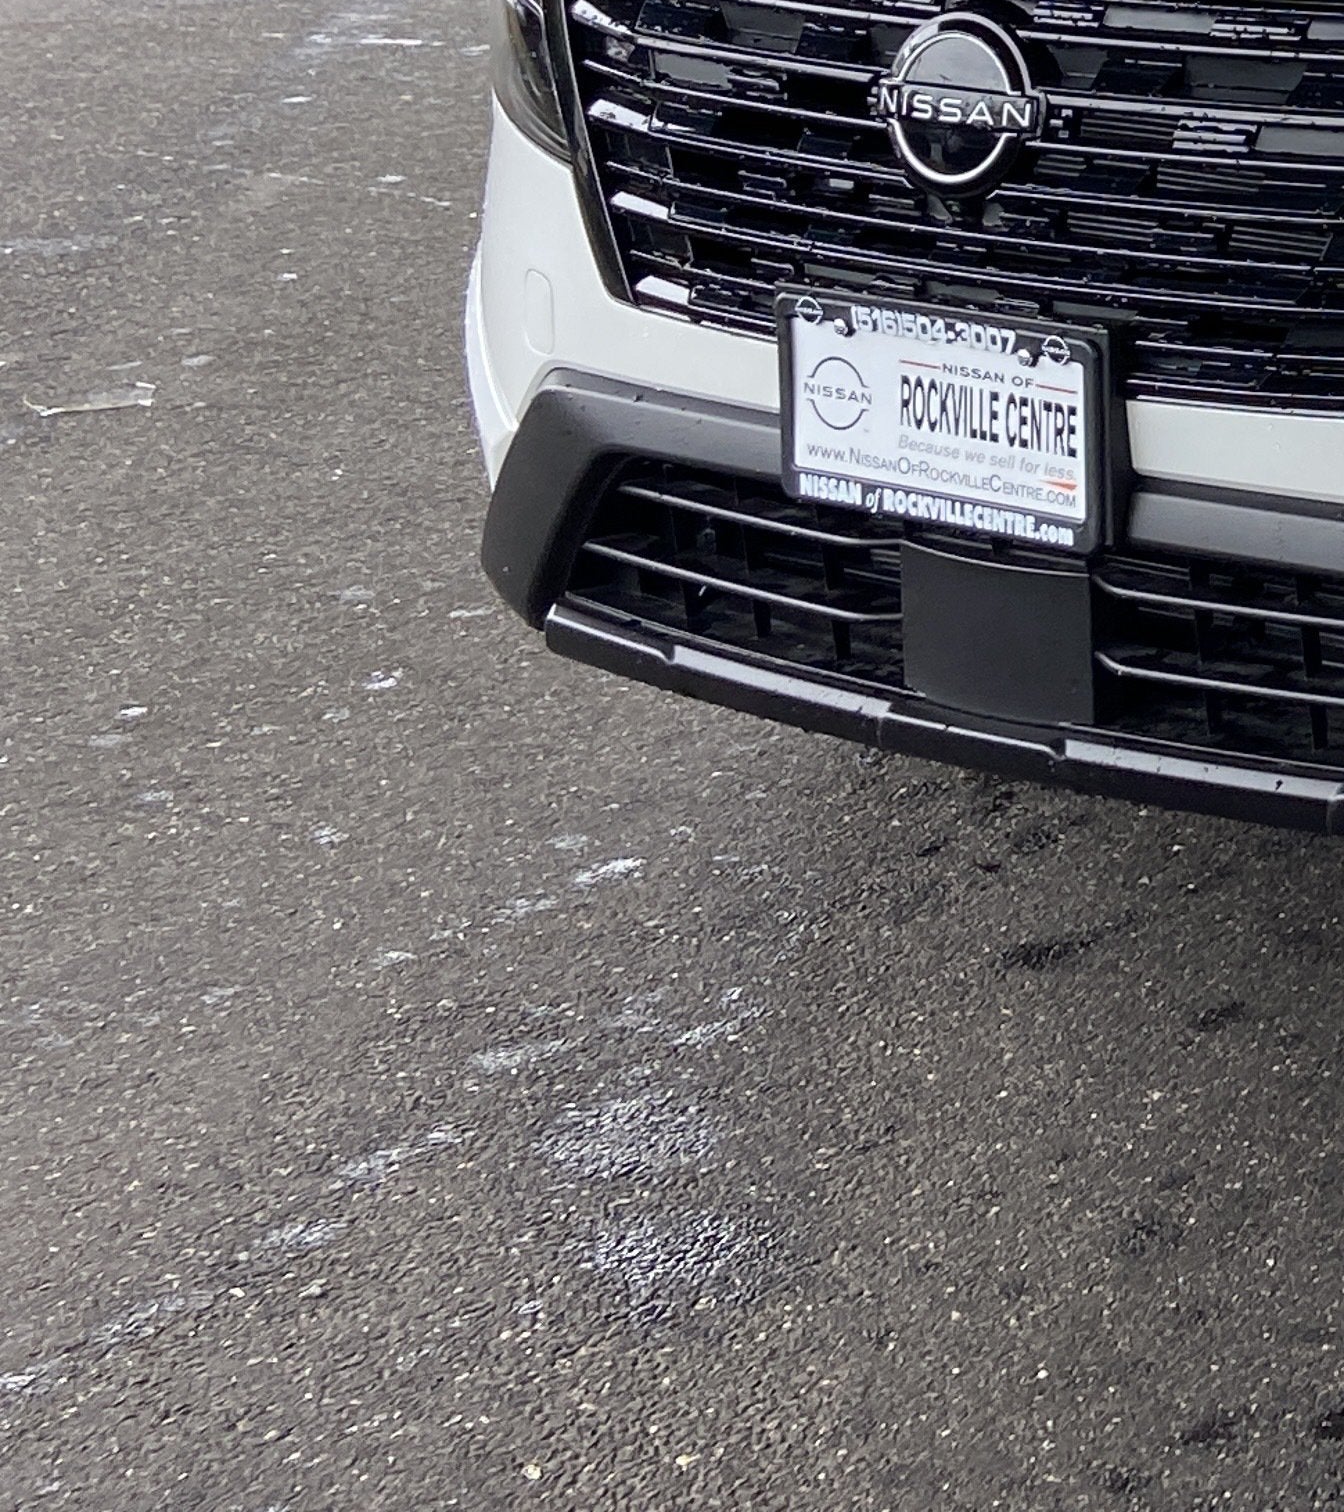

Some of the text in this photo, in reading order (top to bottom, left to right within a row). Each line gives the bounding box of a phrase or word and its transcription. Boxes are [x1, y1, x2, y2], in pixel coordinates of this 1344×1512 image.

[879, 87, 1032, 127] NISSAN
[804, 382, 872, 405] NISSAN
[942, 363, 1035, 388] NISSAN OF
[900, 374, 1077, 458] ROCKVILLE CENTRE
[899, 434, 959, 459] Because
[965, 450, 986, 464] we
[989, 455, 1015, 469] sell
[1019, 457, 1041, 474] for
[800, 473, 1074, 547] NISSAN of ROCKVILLECENTRE.com
